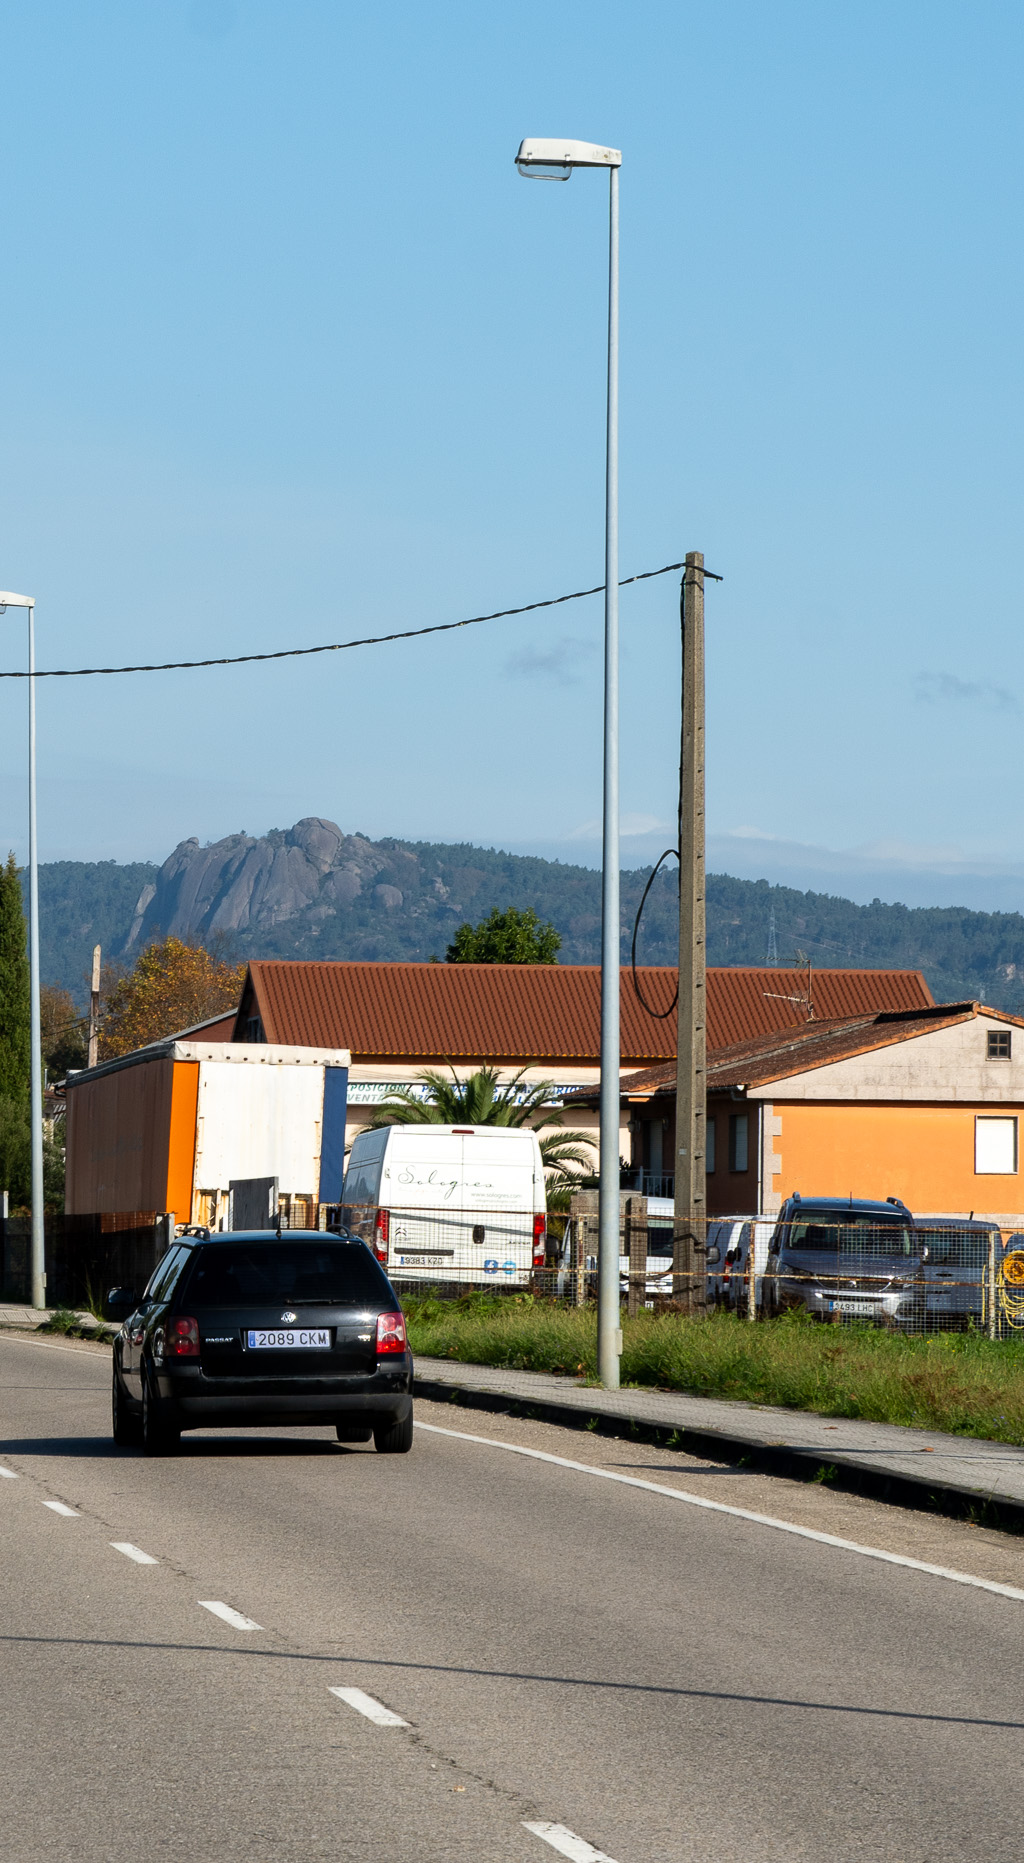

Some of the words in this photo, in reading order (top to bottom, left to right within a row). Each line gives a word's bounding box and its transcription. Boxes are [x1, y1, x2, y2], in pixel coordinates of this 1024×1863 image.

[404, 1256, 426, 1265] 9383
[857, 1303, 873, 1312] LHC
[258, 1332, 295, 1346] 2089
[299, 1332, 327, 1345] CKM
